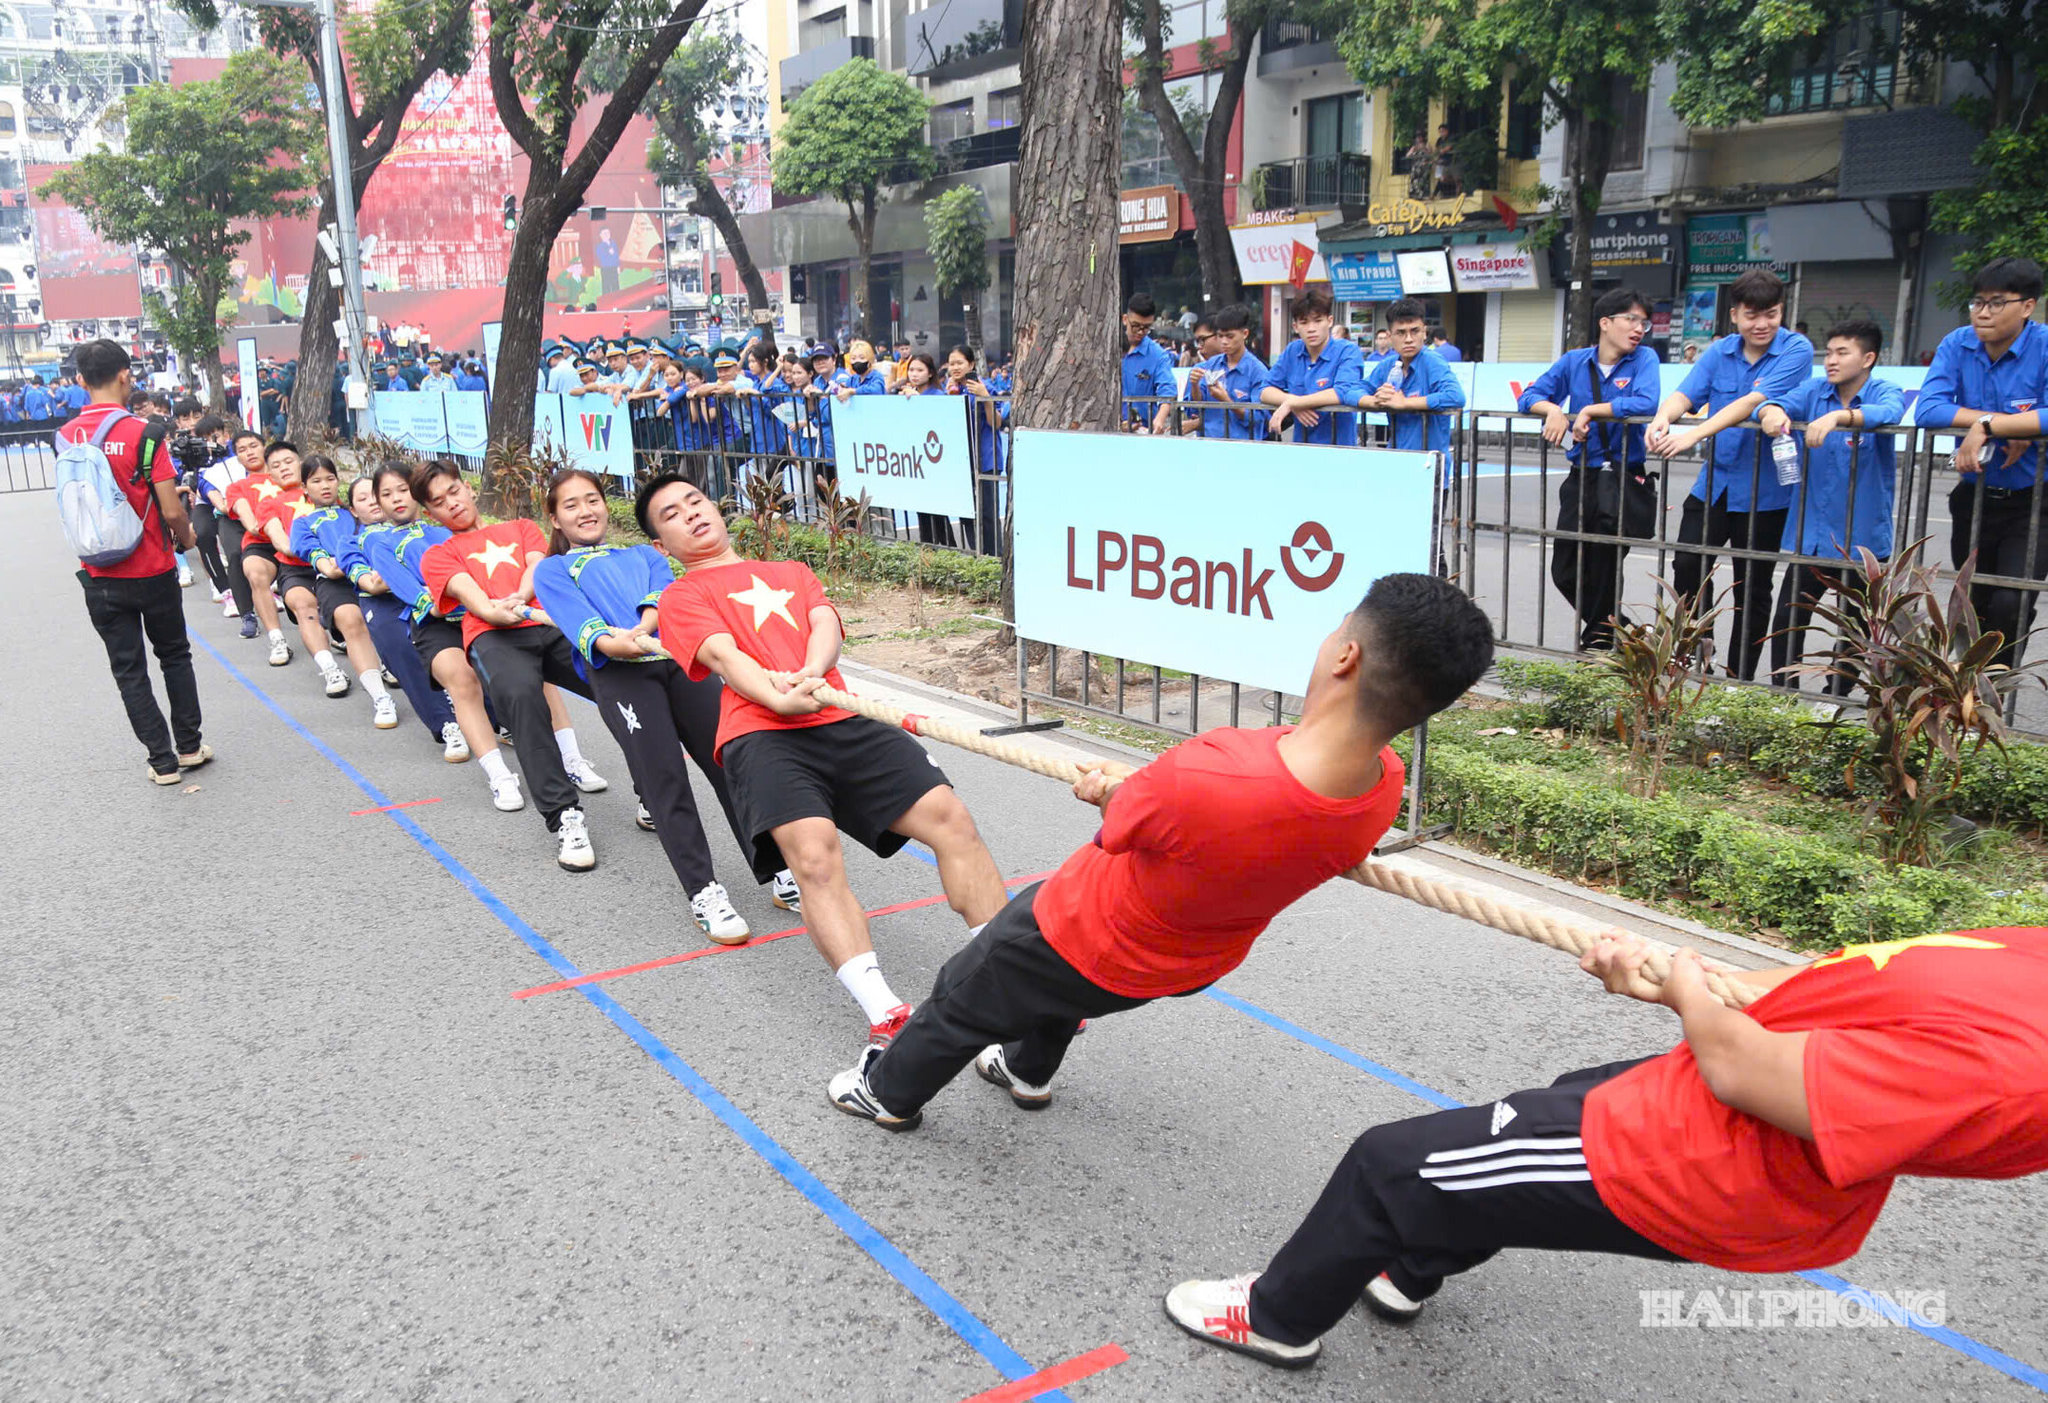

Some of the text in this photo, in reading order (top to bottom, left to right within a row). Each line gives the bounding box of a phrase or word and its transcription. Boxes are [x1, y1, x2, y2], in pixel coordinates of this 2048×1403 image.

[1147, 196, 1168, 220] HUA
[1388, 223, 1405, 236] Egg
[1337, 263, 1396, 280] Kim Travel
[1457, 256, 1525, 273] Singapore
[1690, 264, 1711, 273] FREE
[852, 441, 925, 480] LPBank
[1067, 525, 1276, 621] LPBank
